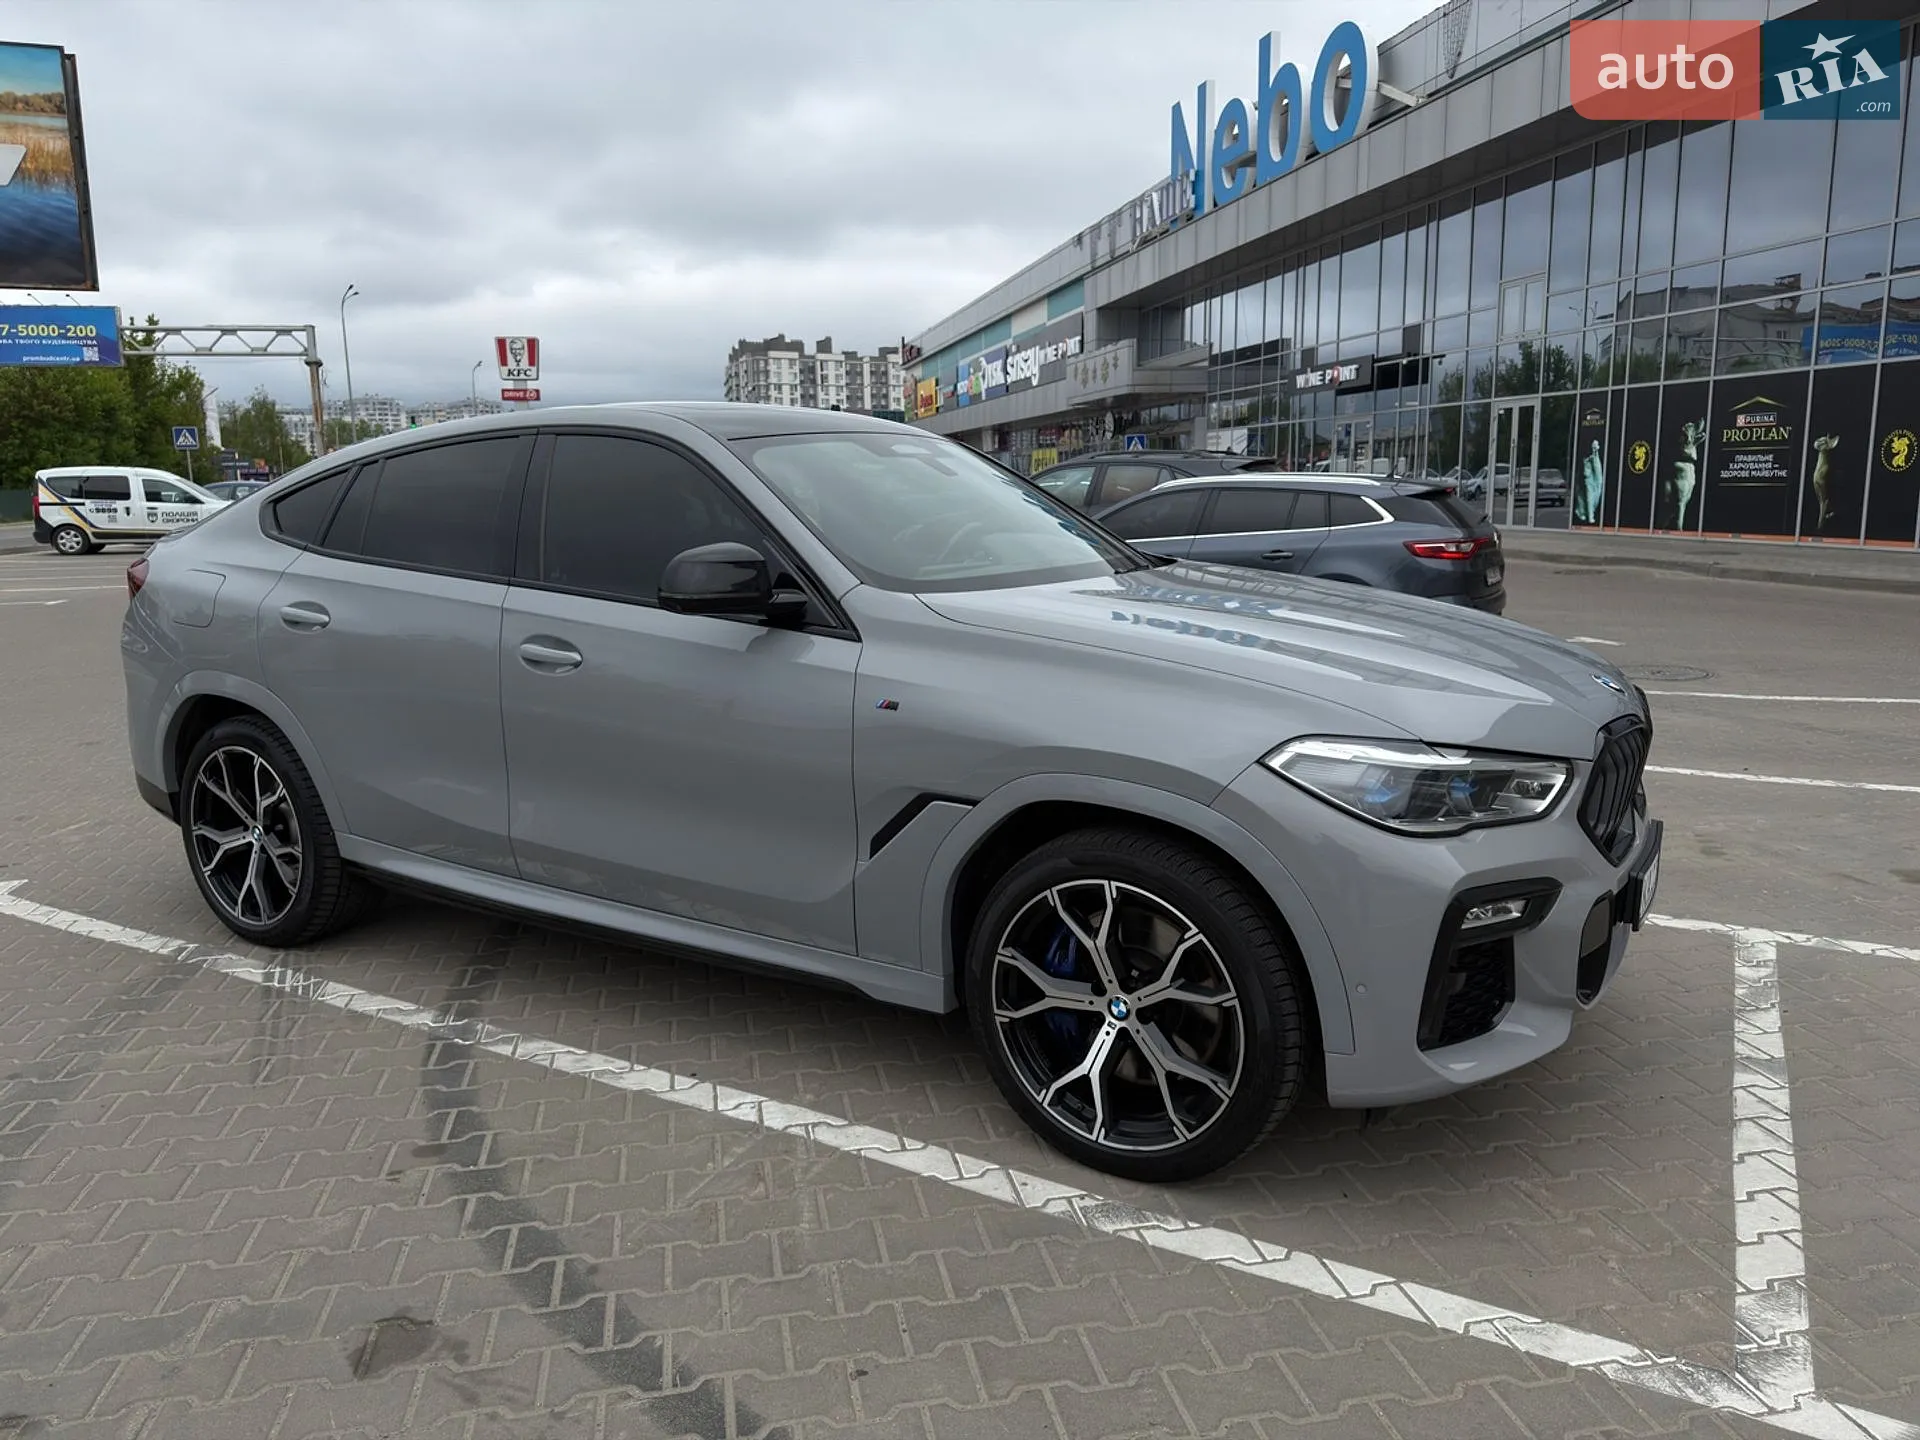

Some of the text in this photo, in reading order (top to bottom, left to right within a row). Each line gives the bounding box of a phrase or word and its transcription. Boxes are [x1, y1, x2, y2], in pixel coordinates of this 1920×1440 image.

[1170, 20, 1377, 227] Nebo
[0, 324, 96, 337] 7-5000-200
[507, 368, 532, 377] KFC
[1296, 367, 1325, 389] WINE
[1745, 415, 1775, 424] PURINA
[1722, 426, 1789, 443] PRO PLAN
